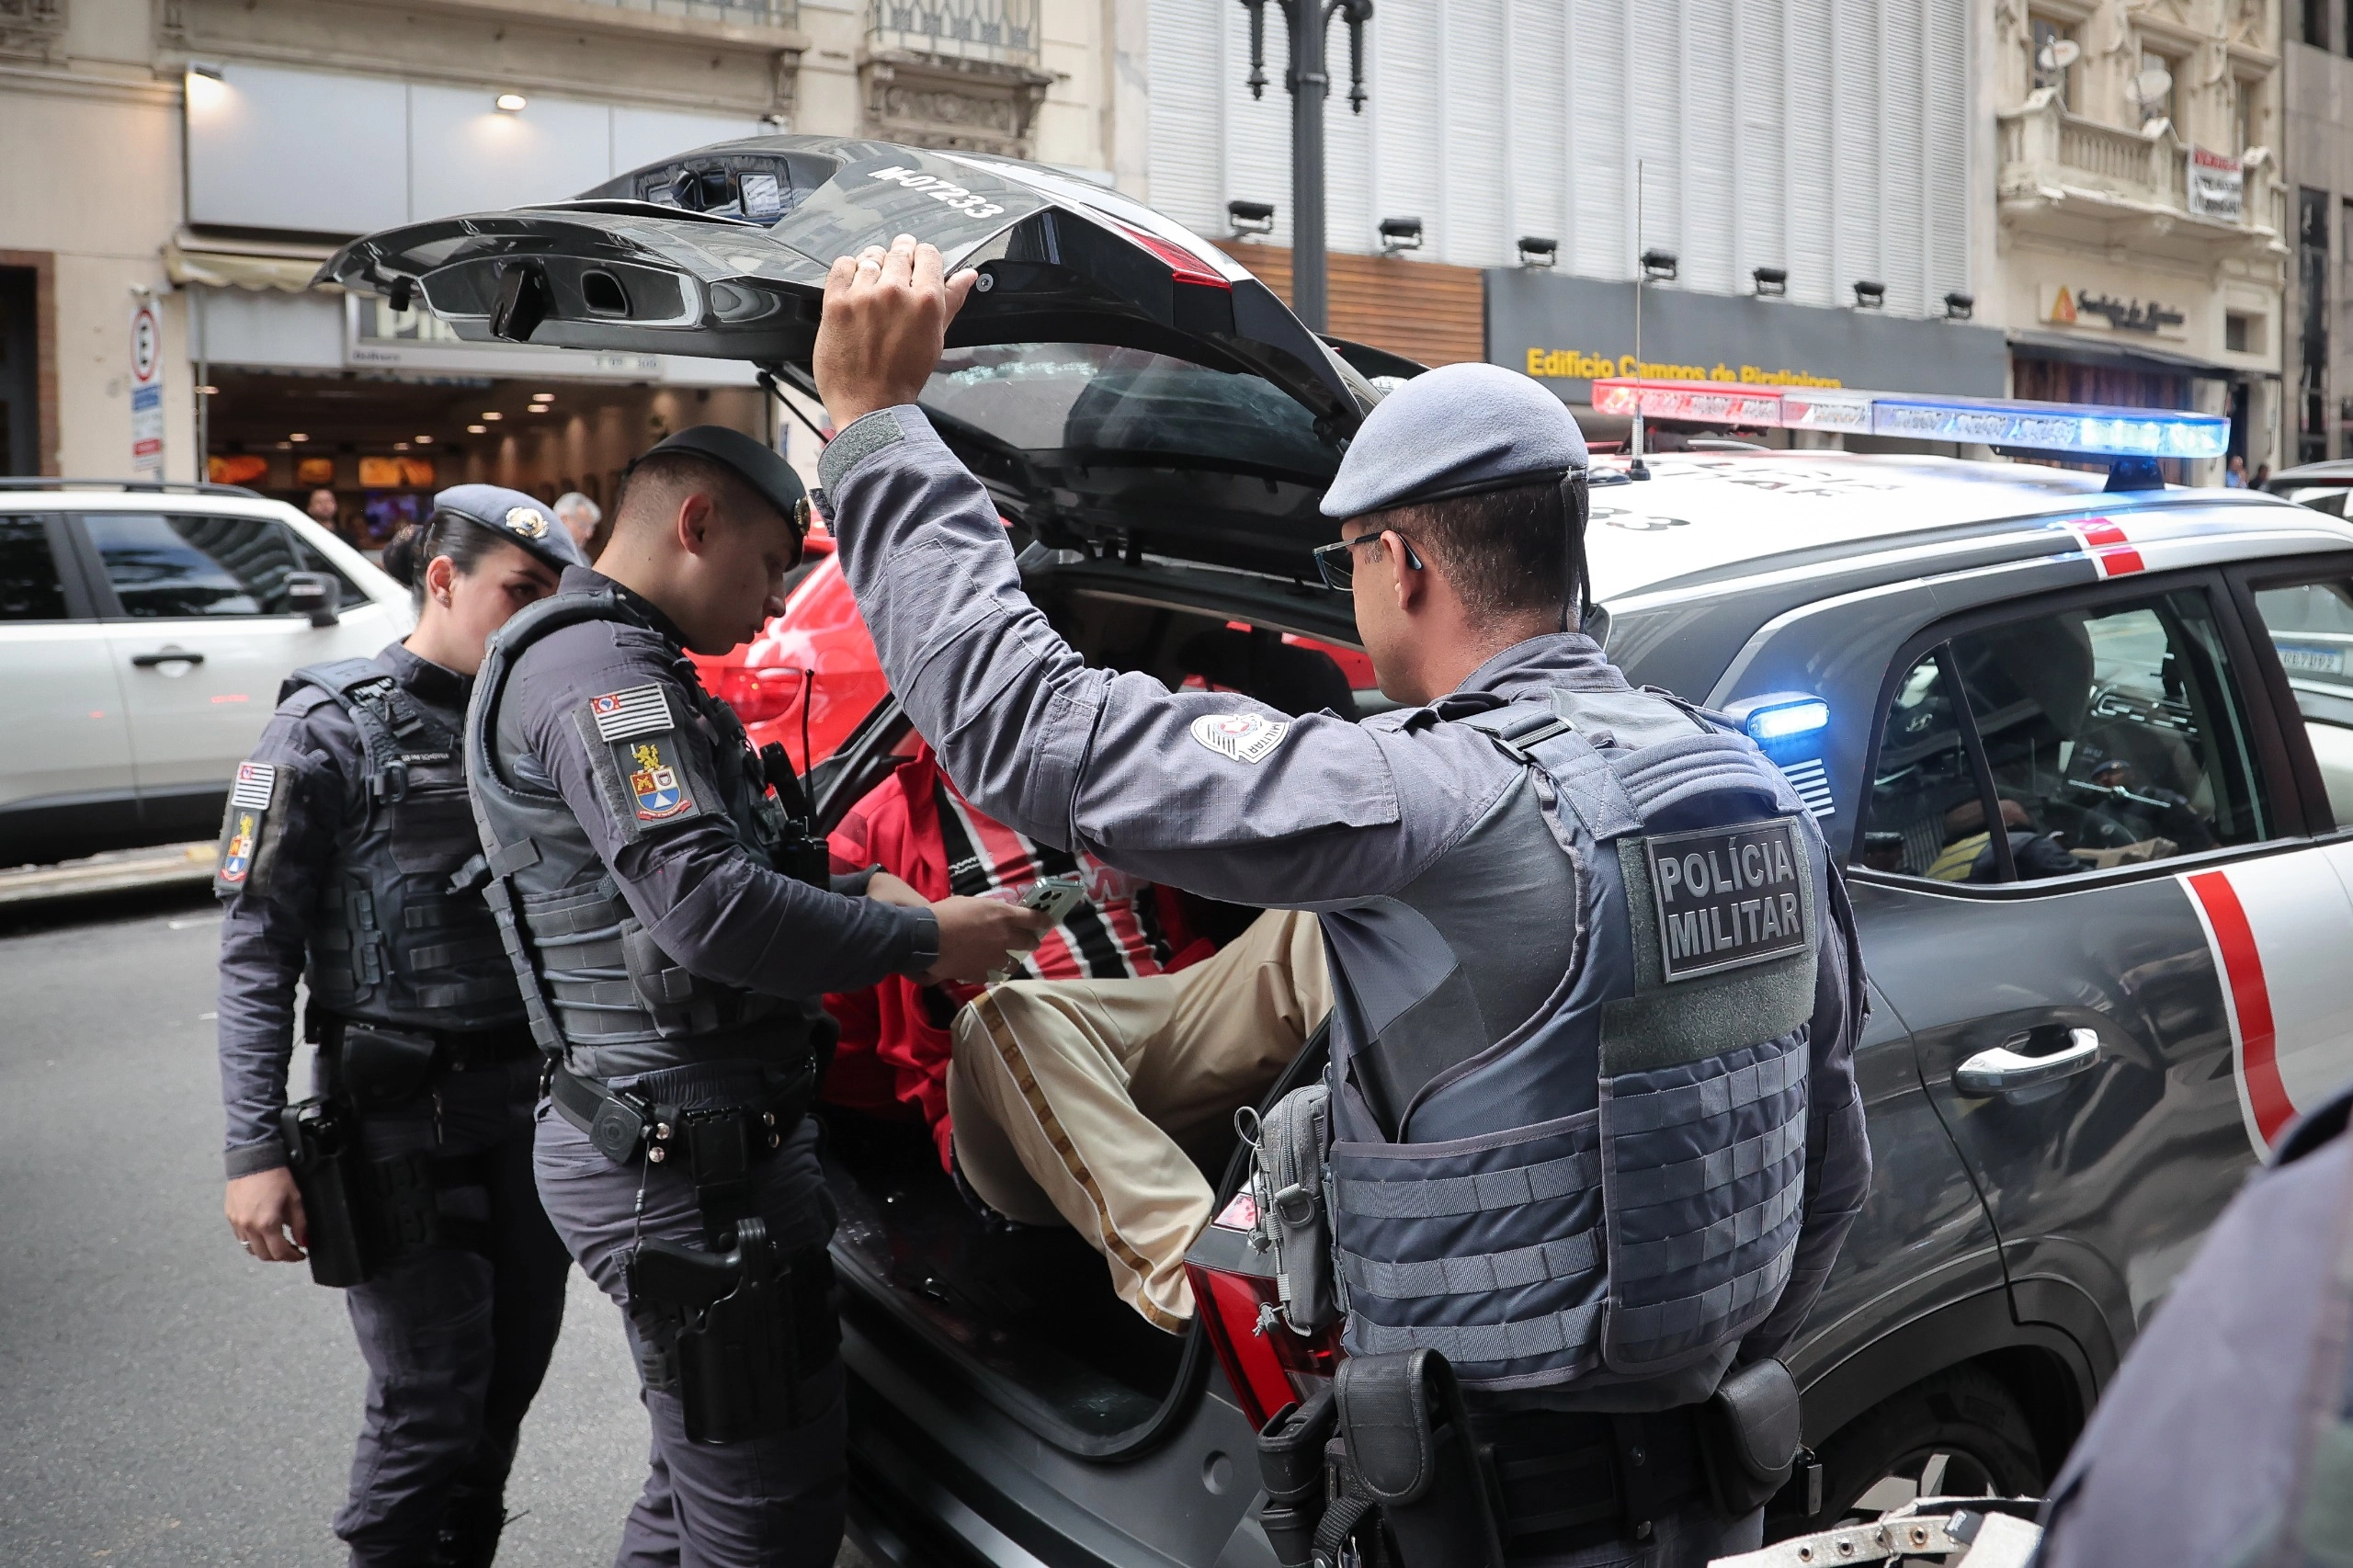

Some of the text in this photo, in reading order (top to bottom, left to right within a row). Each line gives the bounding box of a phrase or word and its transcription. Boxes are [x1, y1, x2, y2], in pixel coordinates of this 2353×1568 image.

[867, 165, 1005, 219] M-07233
[1711, 362, 1737, 382] de
[1247, 723, 1282, 754] MILITAR
[1657, 836, 1795, 903] POLÍCIA
[1667, 892, 1801, 960] MILITAR
